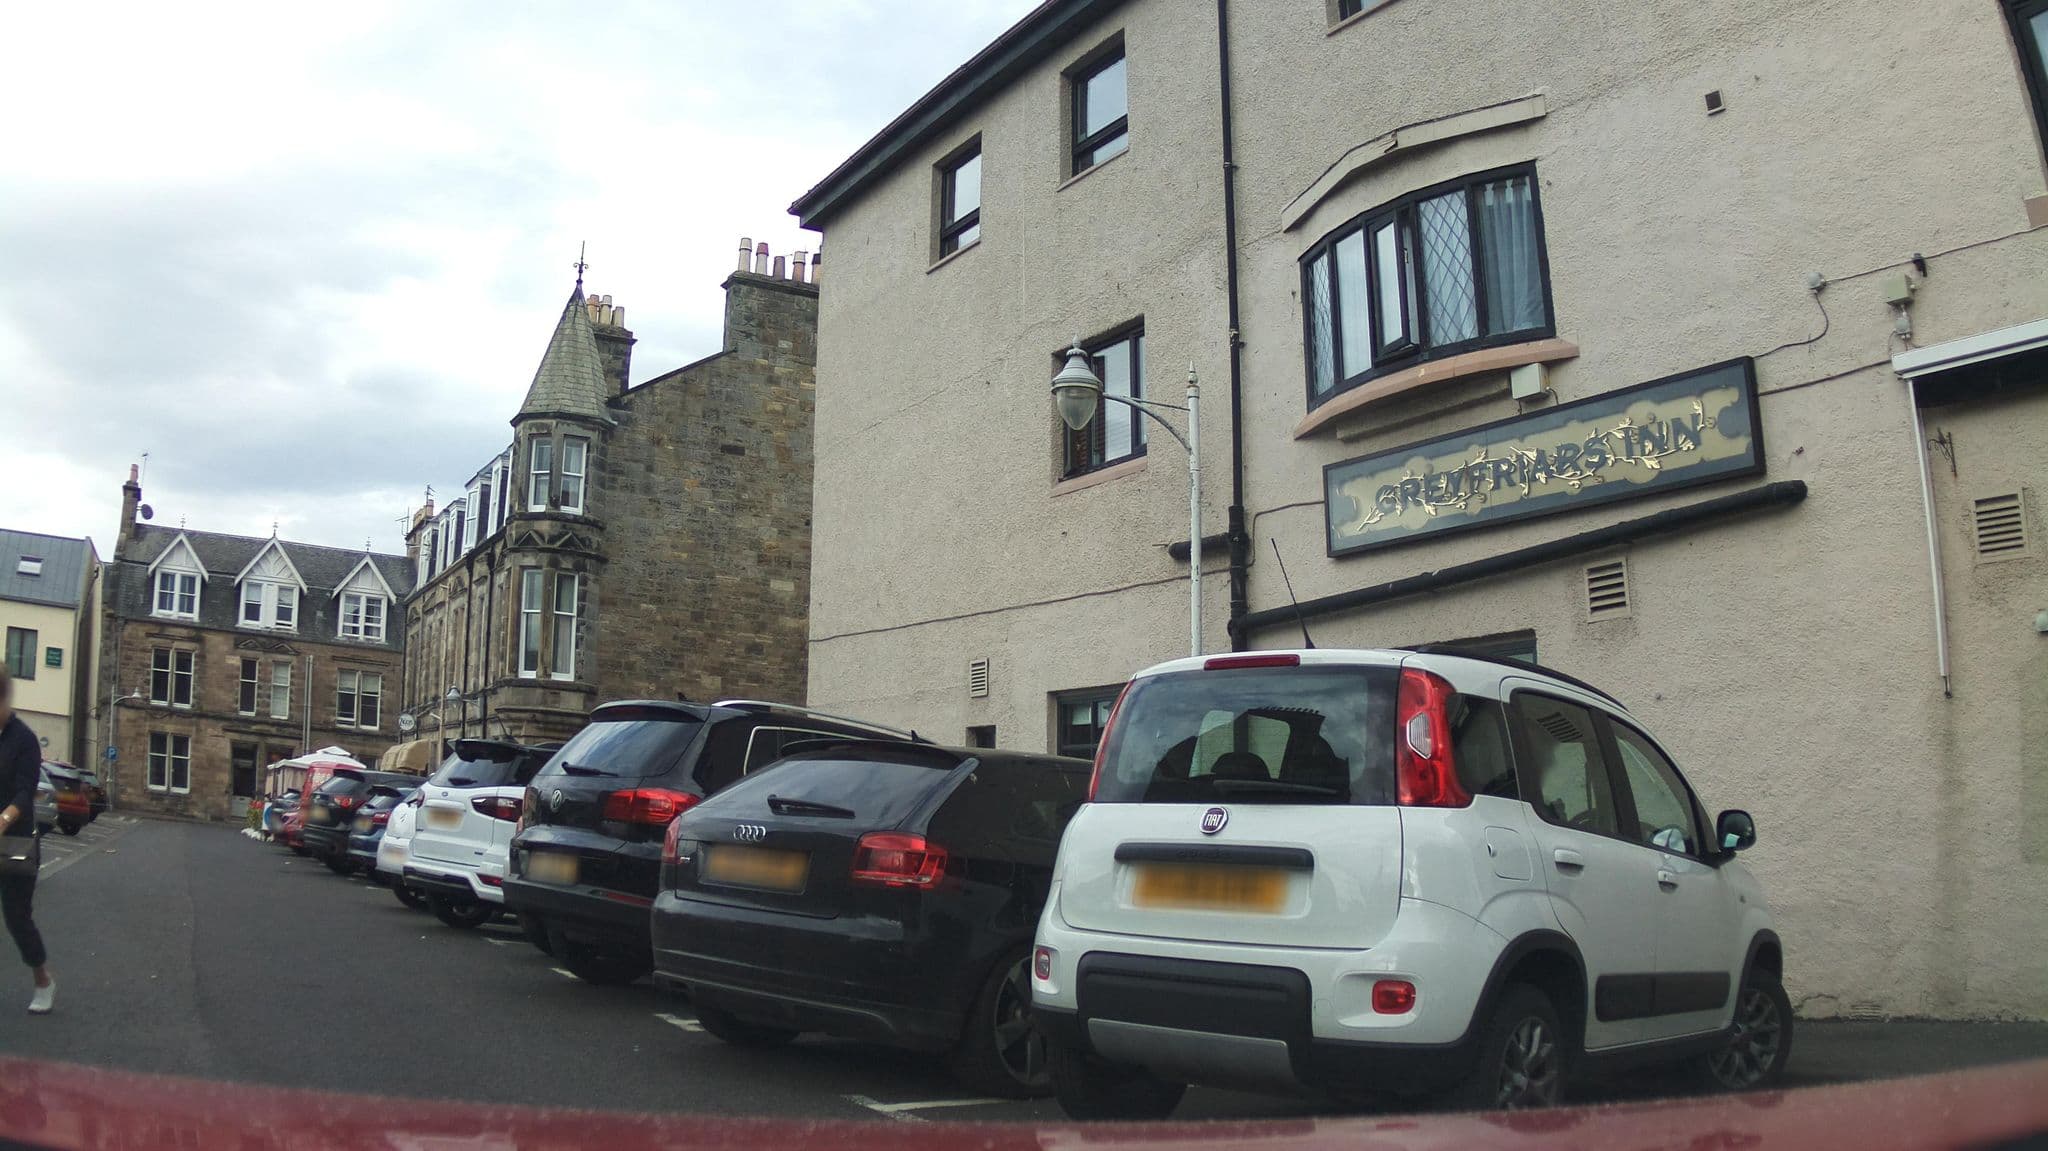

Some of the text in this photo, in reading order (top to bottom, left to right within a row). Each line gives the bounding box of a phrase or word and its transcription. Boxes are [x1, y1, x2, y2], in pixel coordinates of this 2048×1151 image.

[1375, 412, 1702, 515] GREYFRIARS INN
[1203, 813, 1223, 827] FIAT
